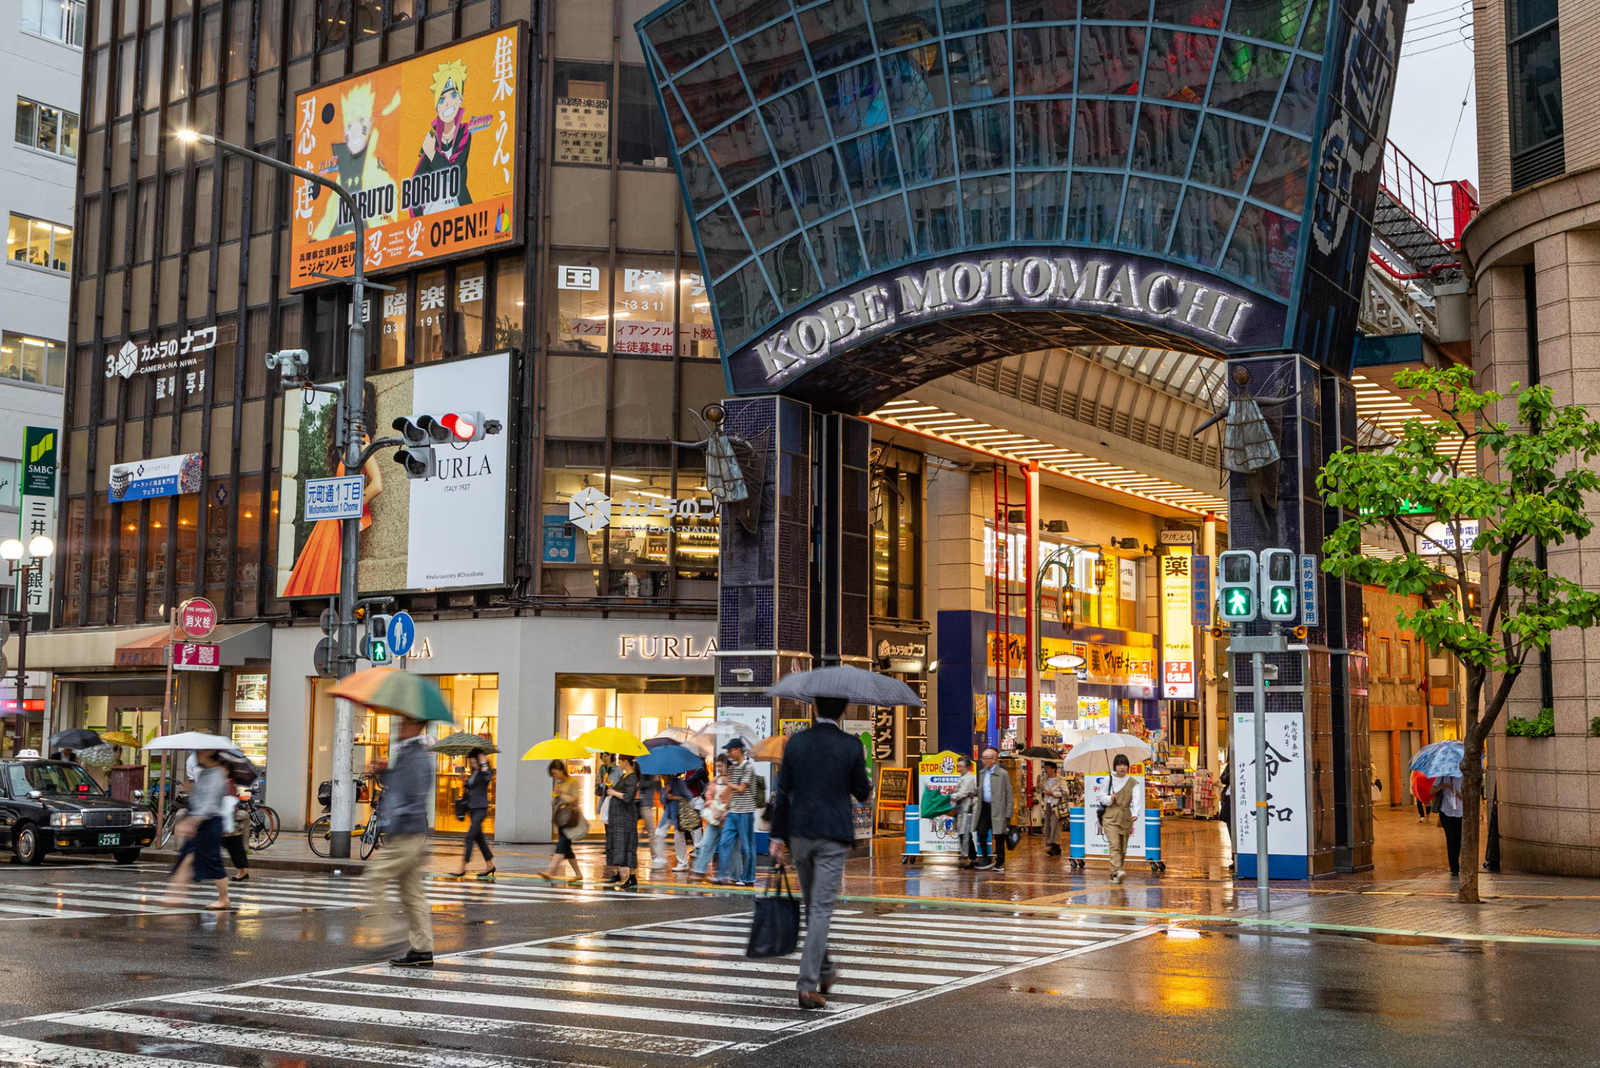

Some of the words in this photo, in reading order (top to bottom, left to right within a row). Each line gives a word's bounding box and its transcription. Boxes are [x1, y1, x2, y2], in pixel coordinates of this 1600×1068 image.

[401, 166, 460, 210] BORUTO
[430, 211, 489, 248] OPEN!!
[624, 300, 664, 312] (331)
[754, 284, 889, 379] KOBE
[896, 256, 1252, 342] MOTOMACHI
[420, 314, 445, 327] 191
[28, 464, 54, 474] SMBC
[425, 454, 492, 482] URLA
[307, 481, 361, 504] 元町通1丁目
[28, 502, 46, 606] 三井銀行
[1165, 556, 1188, 576] 薬
[1302, 558, 1315, 622] 斜め横断専用
[185, 614, 211, 628] 消火栓
[619, 635, 718, 660] FURLA
[1171, 662, 1187, 672] 2F
[876, 706, 893, 760] カメラ
[921, 763, 939, 773] STOP
